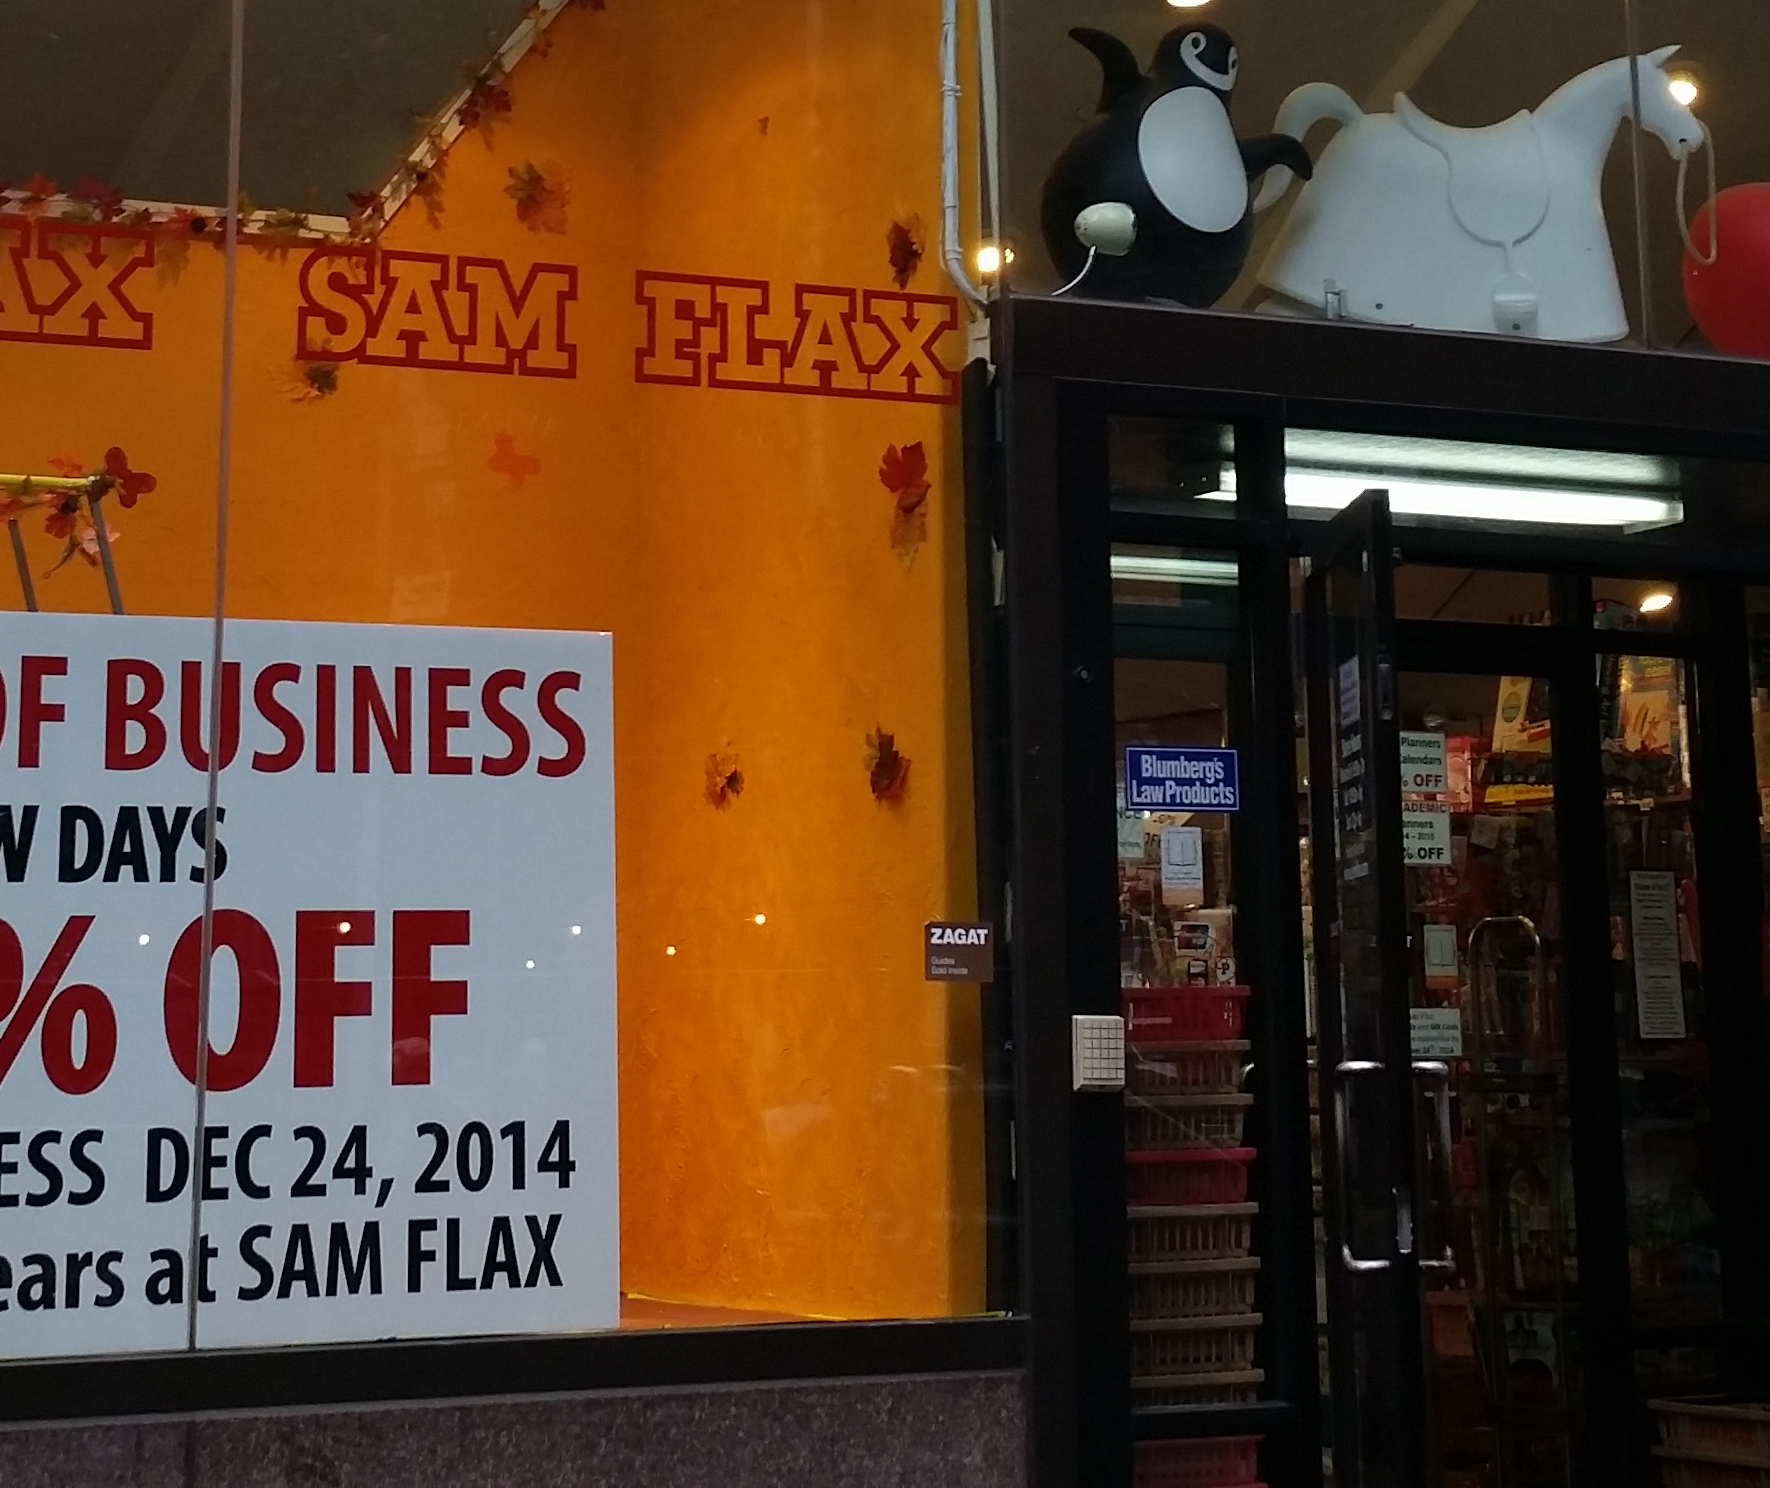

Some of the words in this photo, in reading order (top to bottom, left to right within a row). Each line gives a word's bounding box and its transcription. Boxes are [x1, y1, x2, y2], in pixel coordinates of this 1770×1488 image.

[297, 244, 578, 379] SAM
[635, 268, 960, 405] FLAX
[104, 658, 587, 779] BUSINESS
[1141, 754, 1225, 784] Blumberg's
[1400, 752, 1443, 766] alendars
[1414, 774, 1443, 788] OFF
[1403, 800, 1448, 813] ADEMIC
[58, 804, 228, 884] DAYS
[1417, 847, 1445, 860] OFF
[930, 927, 989, 945] ZAGAT
[163, 908, 471, 1093] OFF
[144, 1124, 273, 1204] DEC
[290, 1124, 396, 1209] 24,
[414, 1118, 577, 1194] 2014
[144, 1232, 219, 1305] at
[237, 1220, 383, 1302] SAM
[406, 1212, 564, 1294] FLAX
